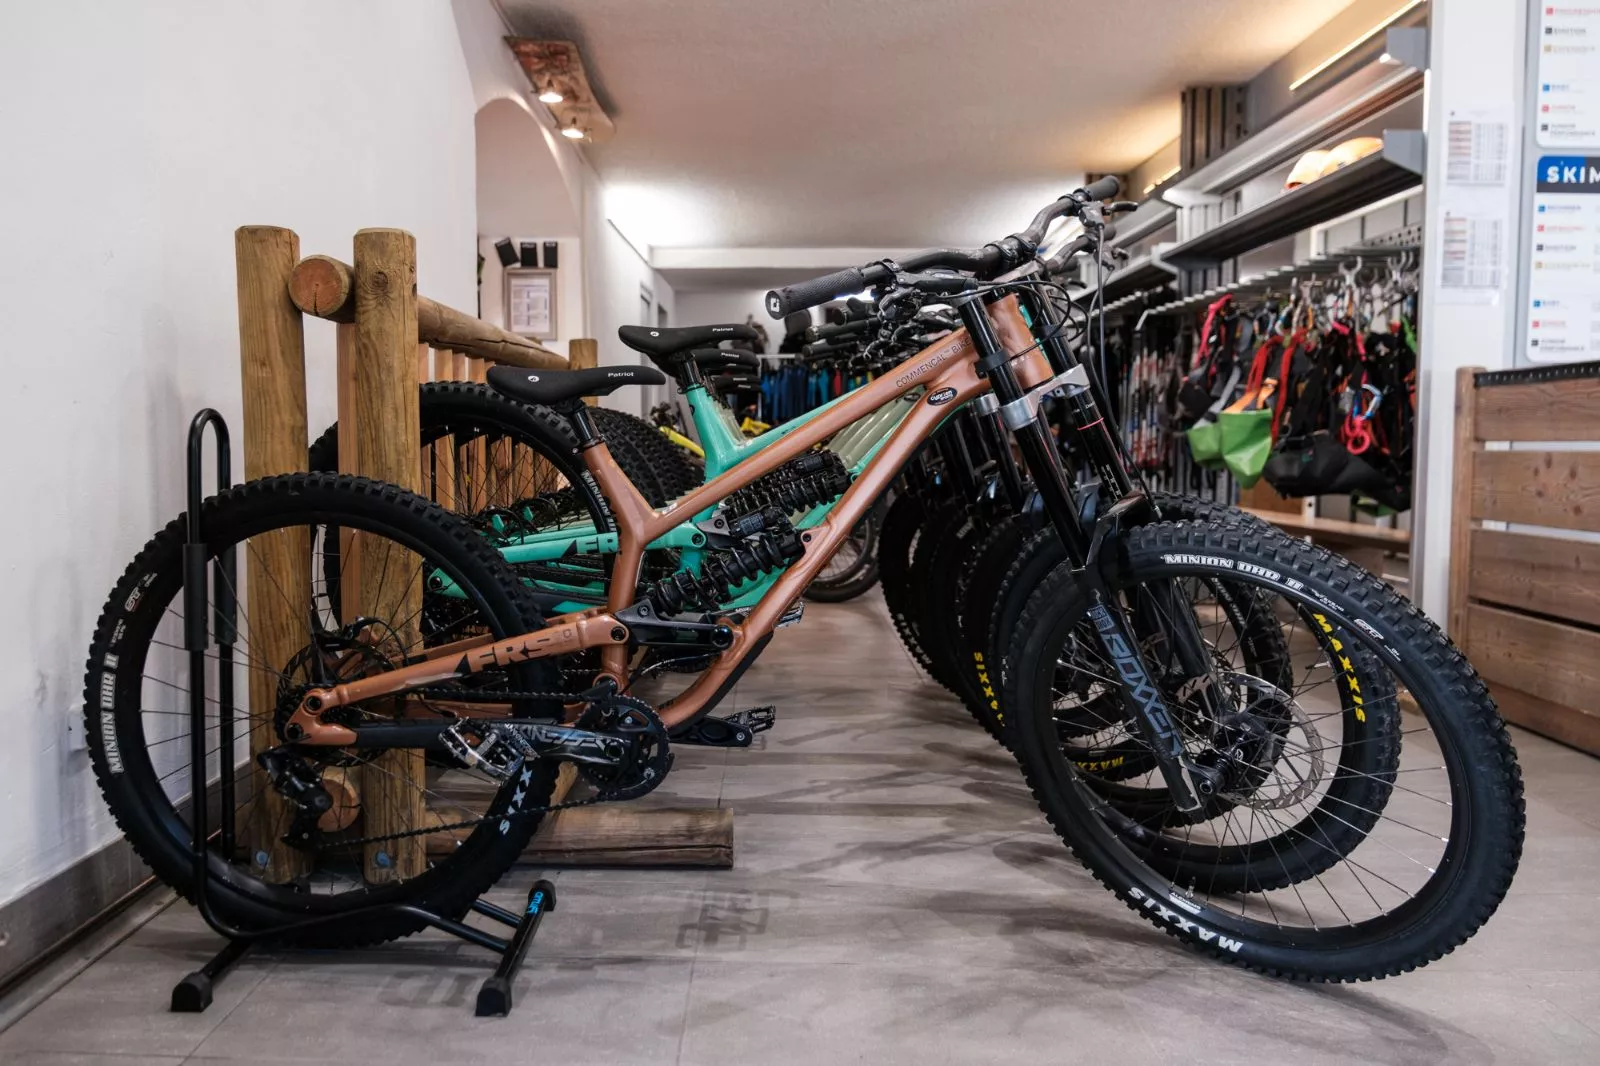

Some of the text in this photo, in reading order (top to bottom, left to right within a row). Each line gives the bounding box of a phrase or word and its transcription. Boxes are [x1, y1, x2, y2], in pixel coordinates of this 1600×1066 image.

[896, 354, 947, 388] COMMENCAL
[1163, 553, 1234, 569] MINION
[1313, 613, 1366, 722] MAXXIS
[101, 711, 125, 773] MINION
[499, 763, 533, 836] XXIS
[1128, 886, 1244, 953] MAXXIS
